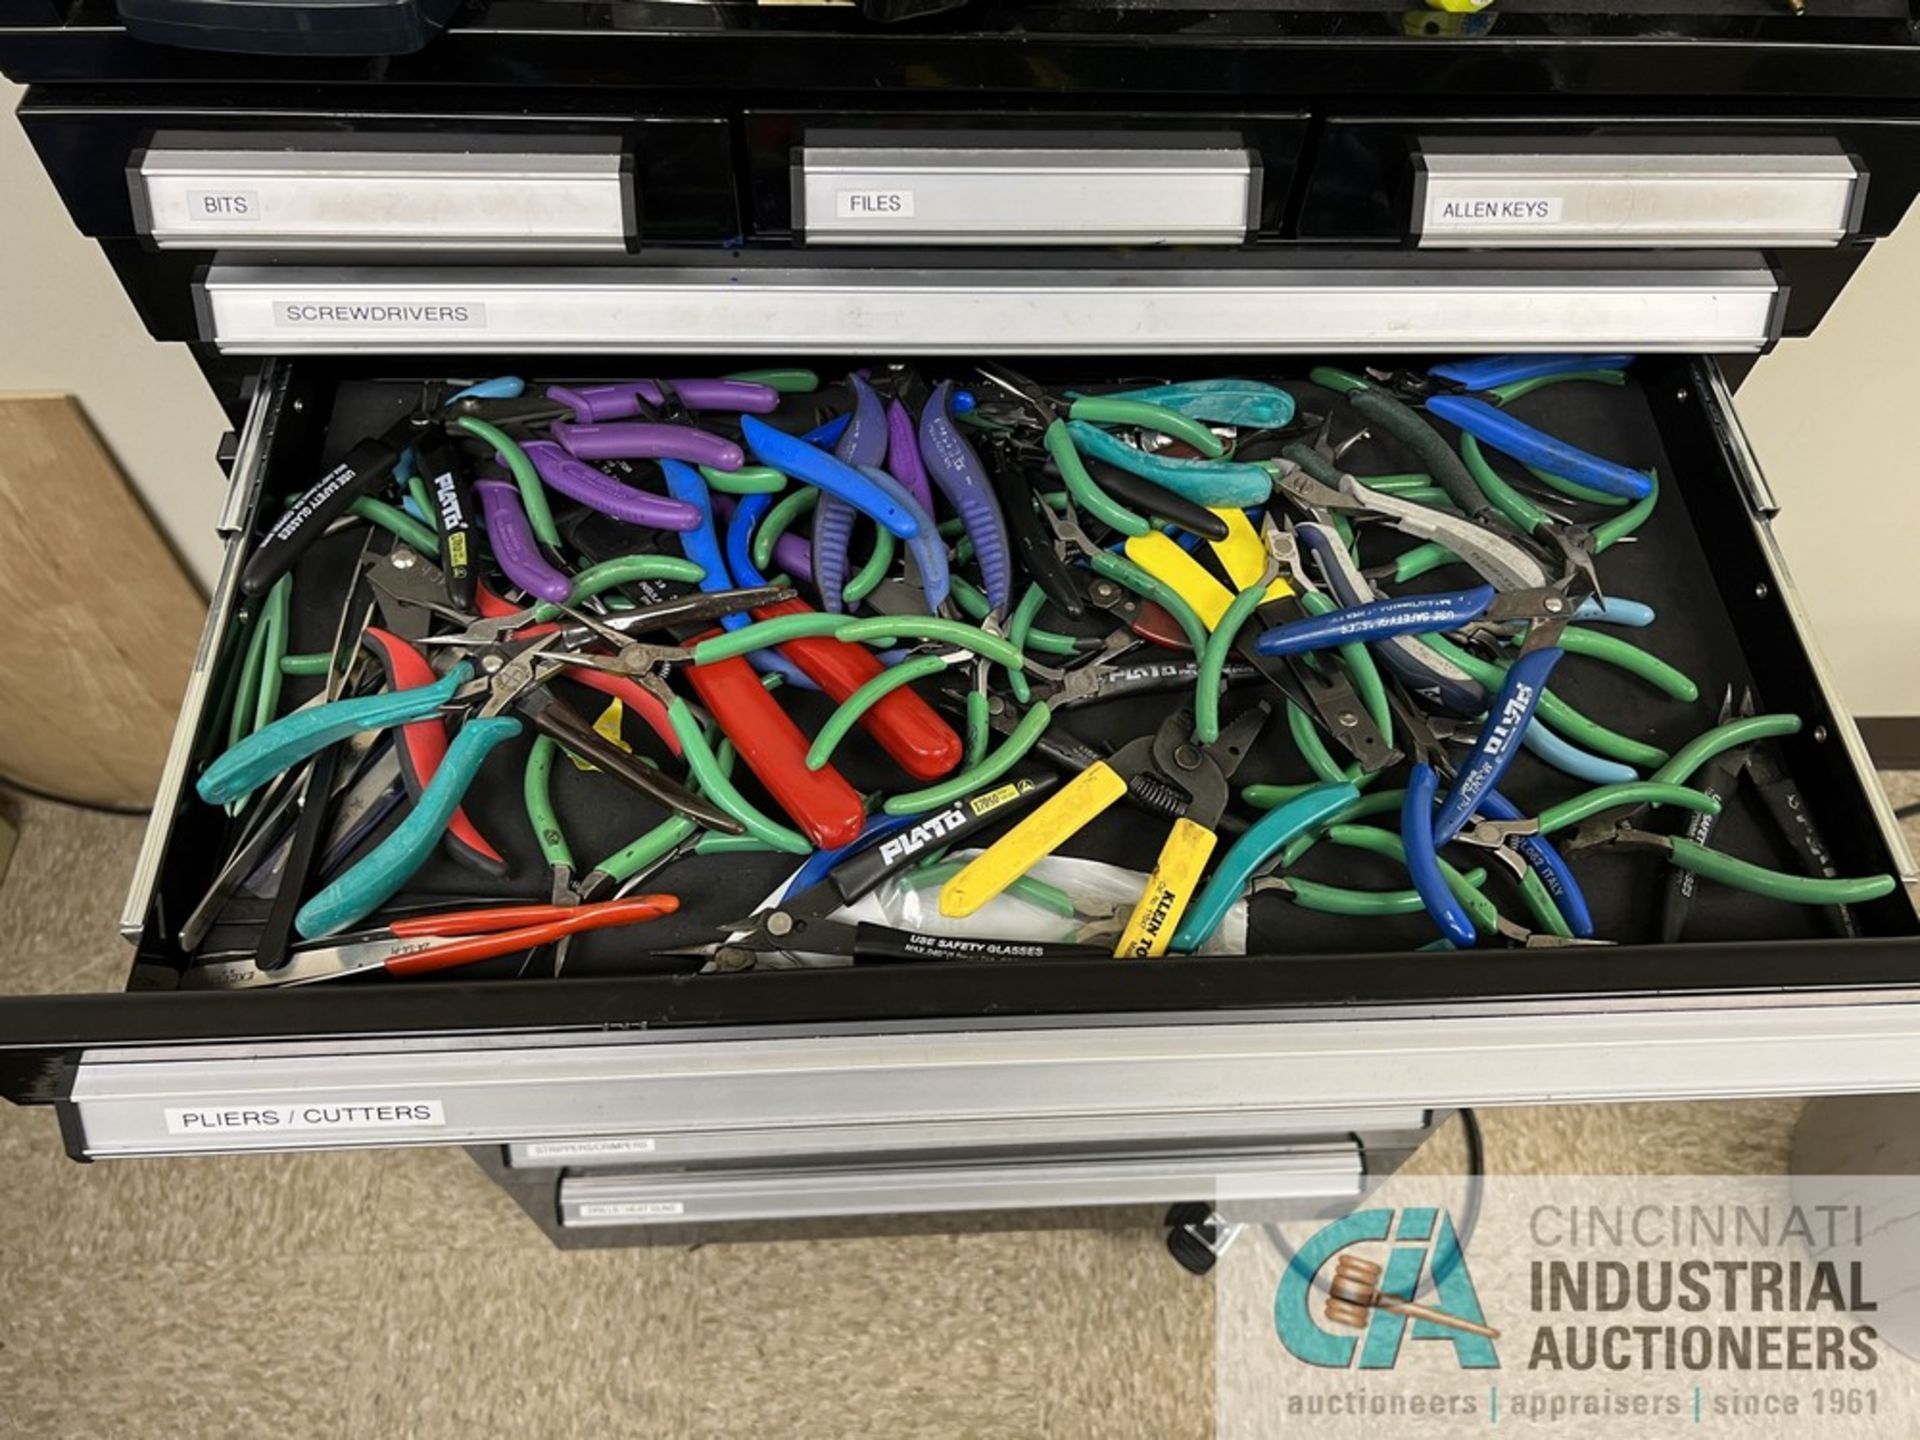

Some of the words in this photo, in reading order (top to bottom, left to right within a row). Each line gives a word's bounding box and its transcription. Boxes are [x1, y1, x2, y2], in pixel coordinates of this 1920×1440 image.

[204, 197, 248, 213] BITS
[850, 194, 902, 212] FILES
[1443, 202, 1498, 217] ALLEN
[1502, 201, 1549, 217] KEYS
[286, 305, 469, 321] SCREWDRIVERS
[879, 809, 967, 866] PLATO
[1541, 867, 1564, 896] ITALY
[1147, 889, 1176, 938] KLEIN
[910, 934, 936, 946] USE
[937, 939, 985, 953] SAFETY
[986, 944, 1044, 958] GLASSES
[182, 1109, 280, 1128] PLIERS
[303, 1104, 431, 1124] CUTTERS
